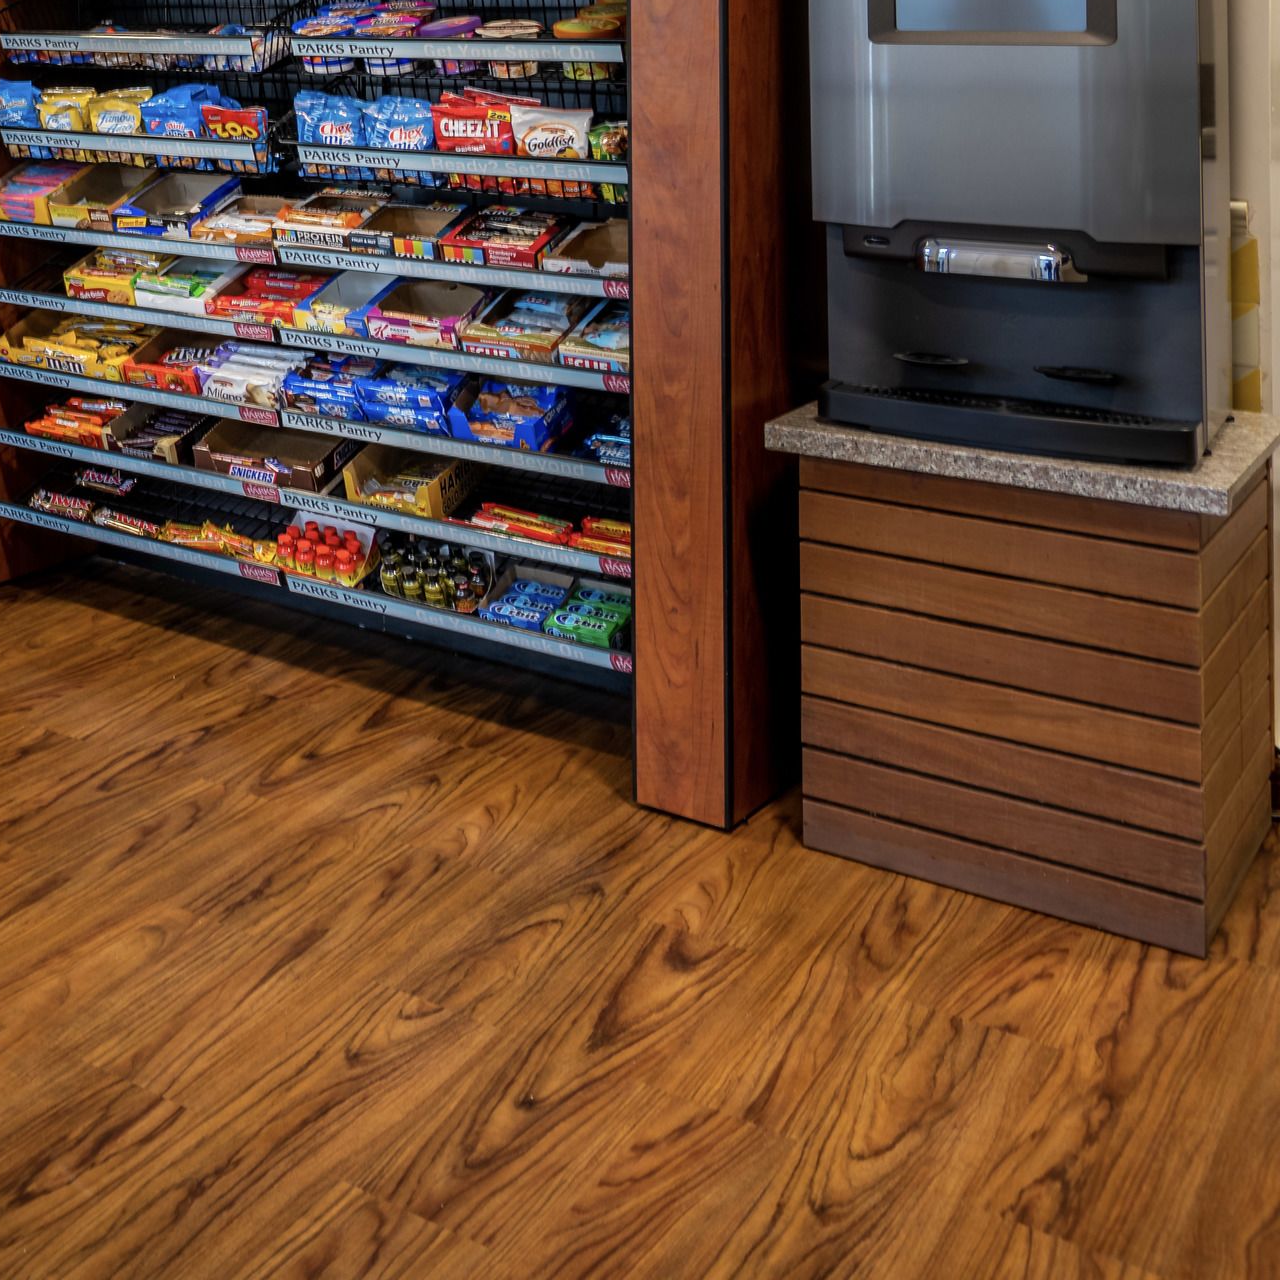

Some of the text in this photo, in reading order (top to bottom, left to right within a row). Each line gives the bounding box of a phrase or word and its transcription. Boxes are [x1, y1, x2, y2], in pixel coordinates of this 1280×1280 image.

[4, 37, 79, 50] PARKS Pantry
[297, 42, 345, 54] PARKS
[349, 43, 395, 58] Pantry
[208, 121, 260, 139] ZOO
[320, 121, 351, 138] Chex
[389, 124, 425, 142] Chex
[6, 133, 43, 145] PARKS
[46, 135, 81, 148] Pantry
[527, 133, 575, 152] Goldfish
[303, 149, 351, 162] PARKS
[355, 152, 400, 168] Pantry
[32, 228, 66, 241] Pantry
[297, 231, 343, 244] PROTEIN
[285, 250, 332, 266] PARKS
[336, 255, 381, 271] Pantry
[32, 296, 66, 310] Pantry
[286, 332, 333, 347] PARKS
[336, 339, 381, 357] Pantry
[36, 372, 70, 387] Pantry
[206, 385, 243, 401] Milano
[287, 414, 334, 430] PARKS
[338, 424, 383, 441] Pantry
[0, 432, 75, 457] PARKS Pantry
[230, 465, 275, 483] SNICKERS
[284, 493, 330, 511] PARKS
[334, 503, 378, 523] Pantry
[37, 515, 70, 532] Pantry
[292, 580, 339, 599] PARKS
[343, 593, 388, 614] Pantry
